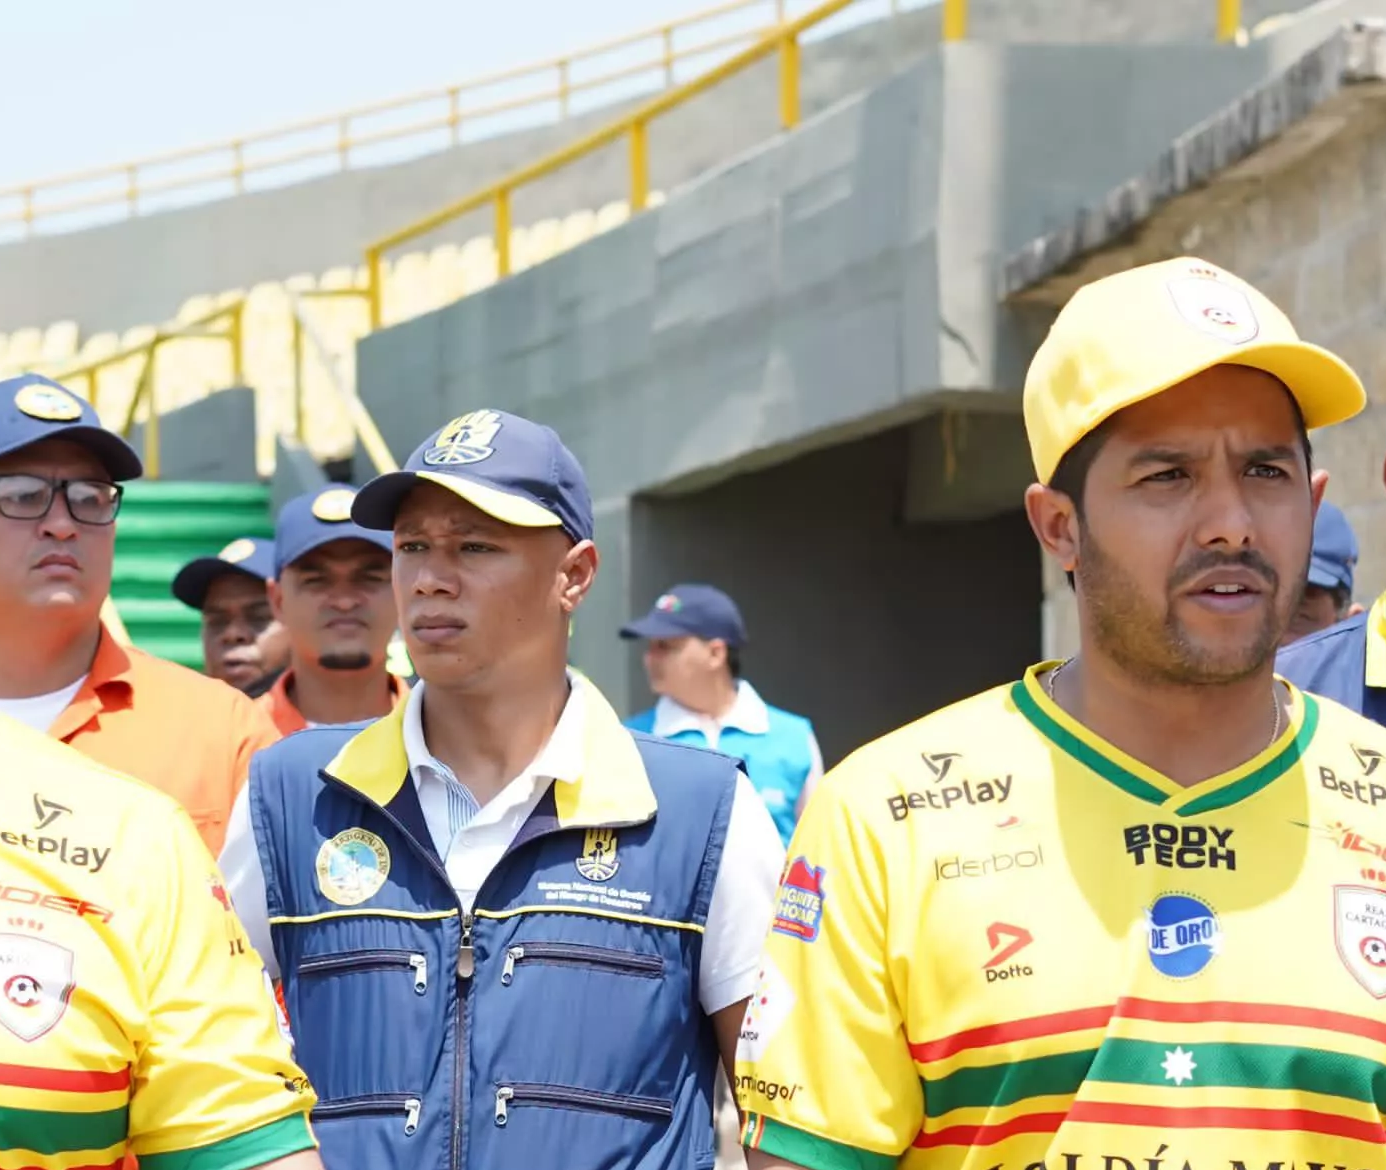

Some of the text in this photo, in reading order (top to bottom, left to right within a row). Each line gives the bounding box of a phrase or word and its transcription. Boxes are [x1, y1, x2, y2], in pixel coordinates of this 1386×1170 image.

[887, 775, 1012, 821] BetPlay
[1124, 824, 1234, 849] BODY
[935, 844, 1044, 880] Iderbol
[1126, 843, 1236, 871] TECH
[1151, 919, 1213, 949] DE ORO
[986, 964, 1033, 983] Dotta
